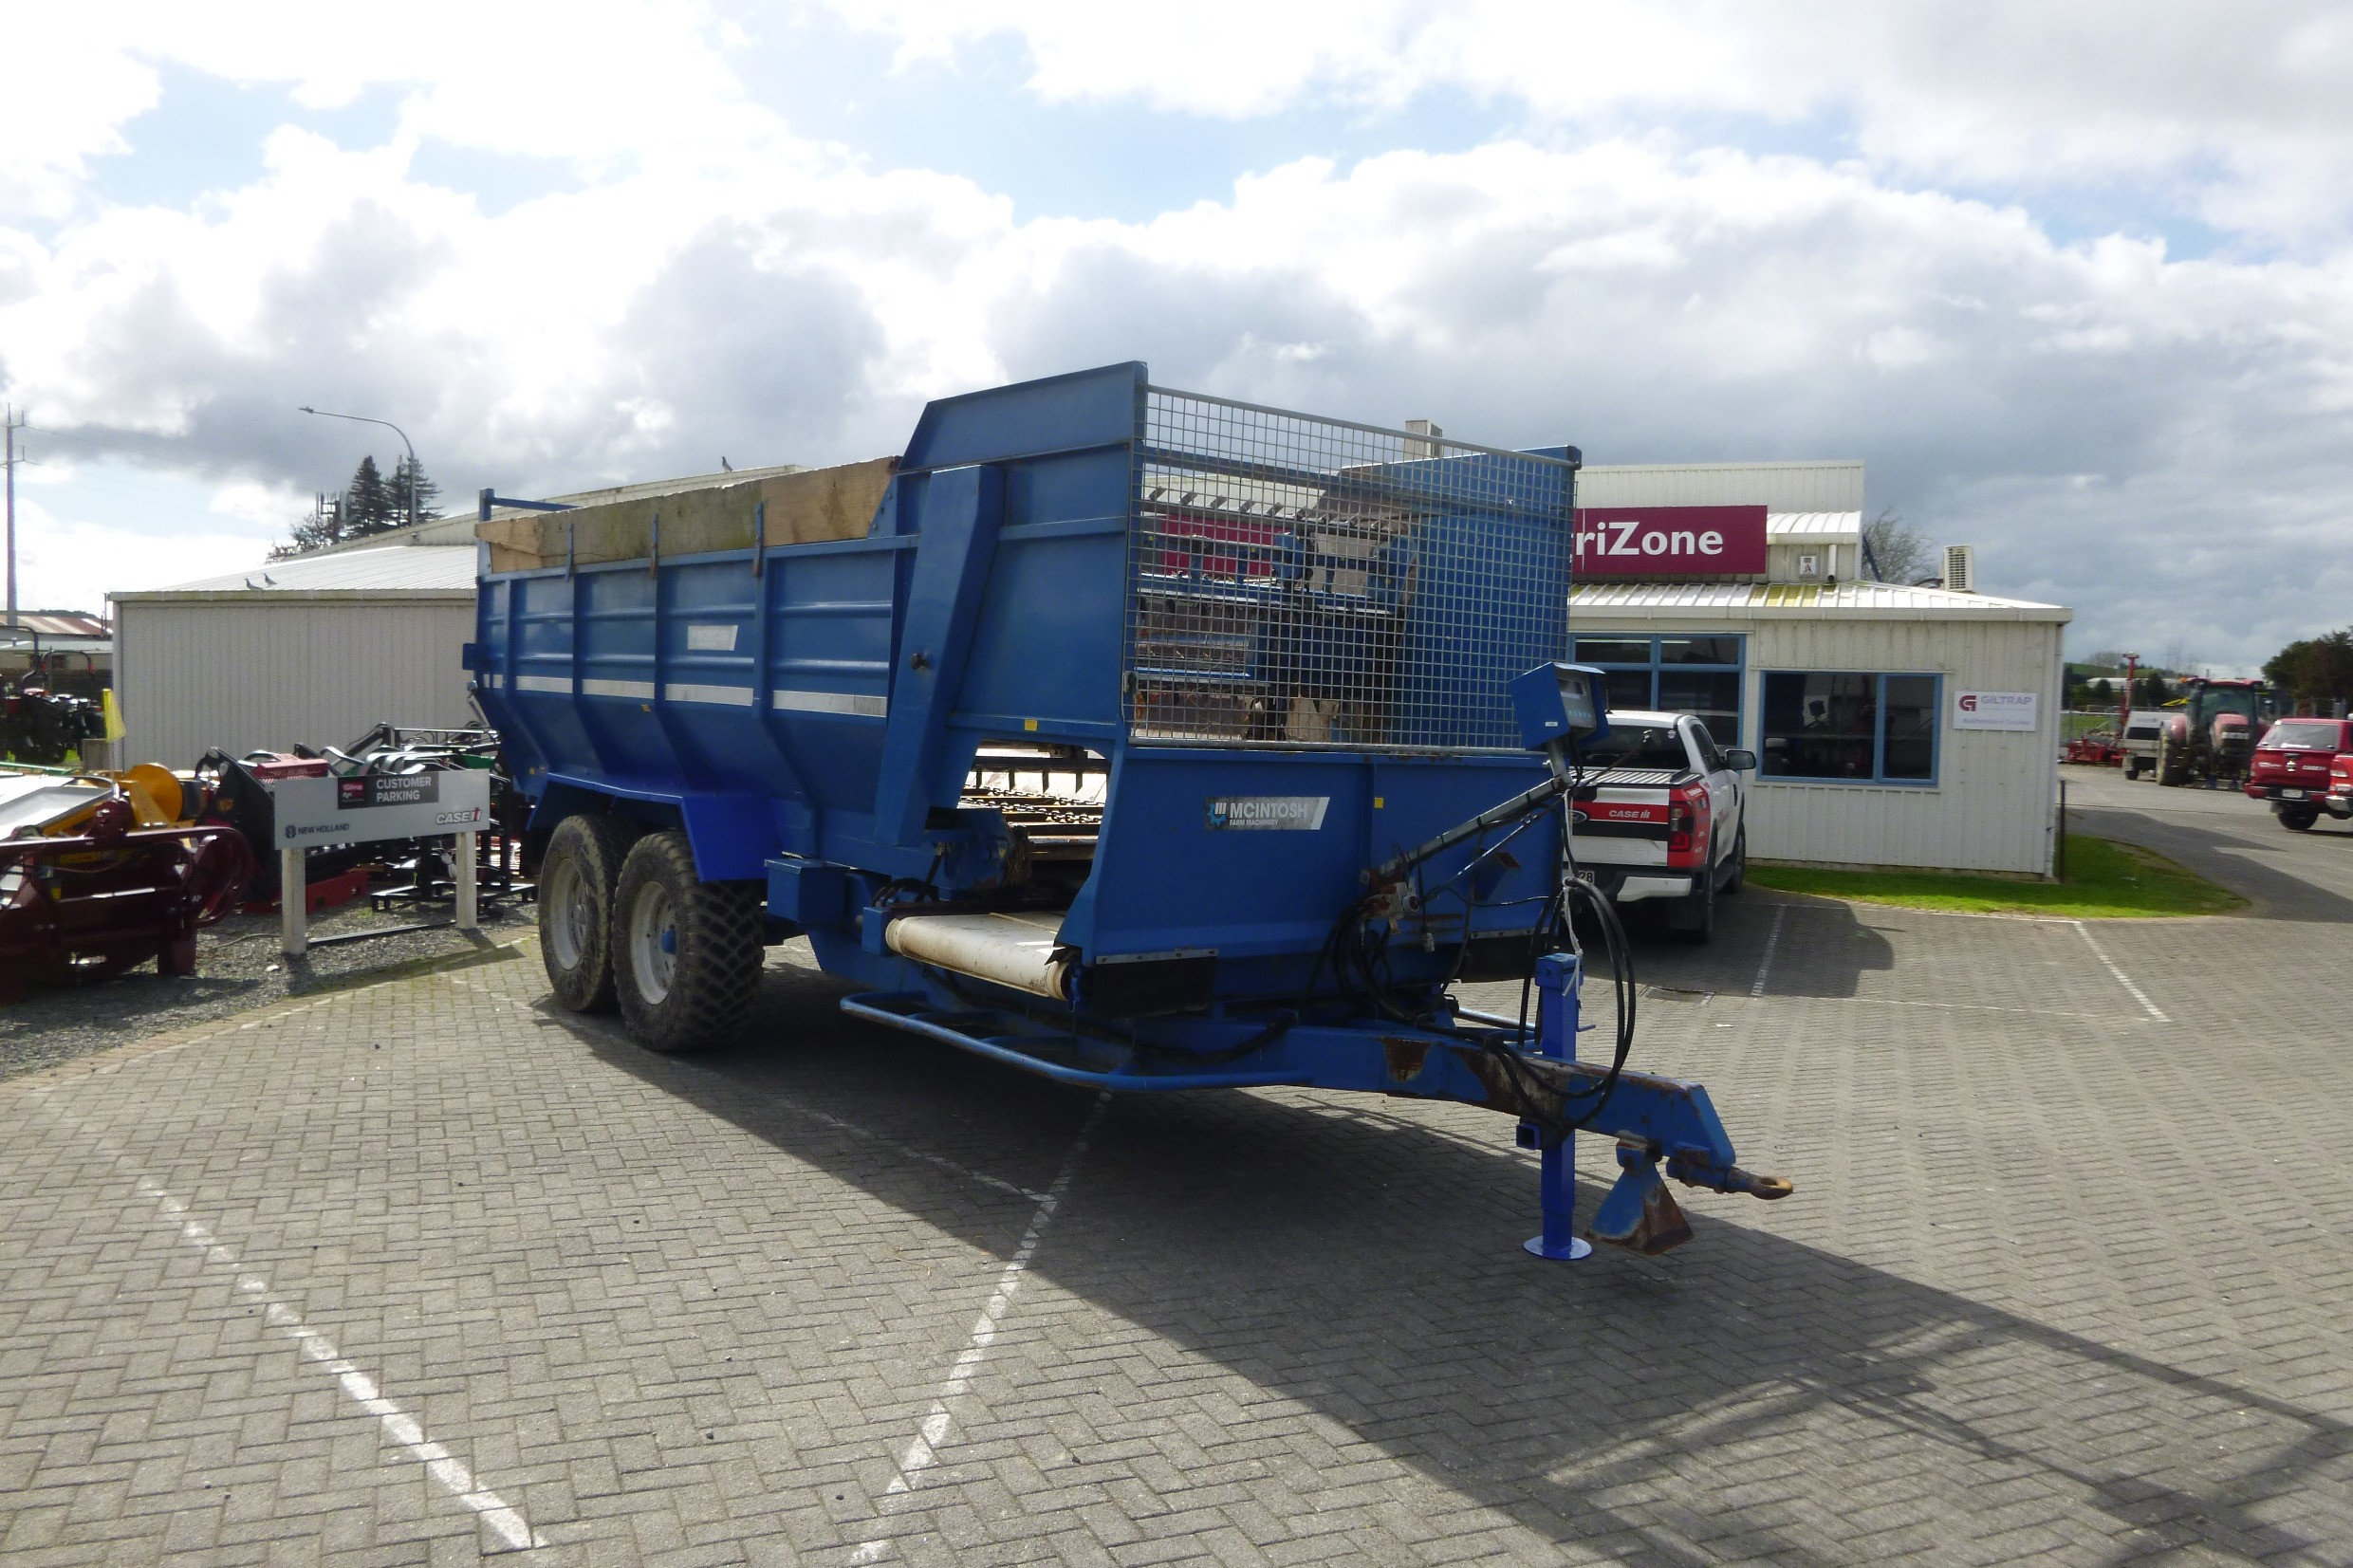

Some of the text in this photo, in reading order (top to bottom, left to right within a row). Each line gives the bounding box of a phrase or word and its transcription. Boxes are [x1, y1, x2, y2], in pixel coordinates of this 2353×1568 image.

[1570, 522, 1723, 555] riZone
[1981, 695, 2031, 706] GILTRAP
[376, 776, 432, 789] CUSTOMER
[377, 790, 420, 802] PARKING
[1230, 802, 1307, 819] MCINTOSH
[1609, 809, 1640, 819] CASE
[436, 811, 470, 824] CASE
[298, 823, 350, 835] NEW HOLLAND
